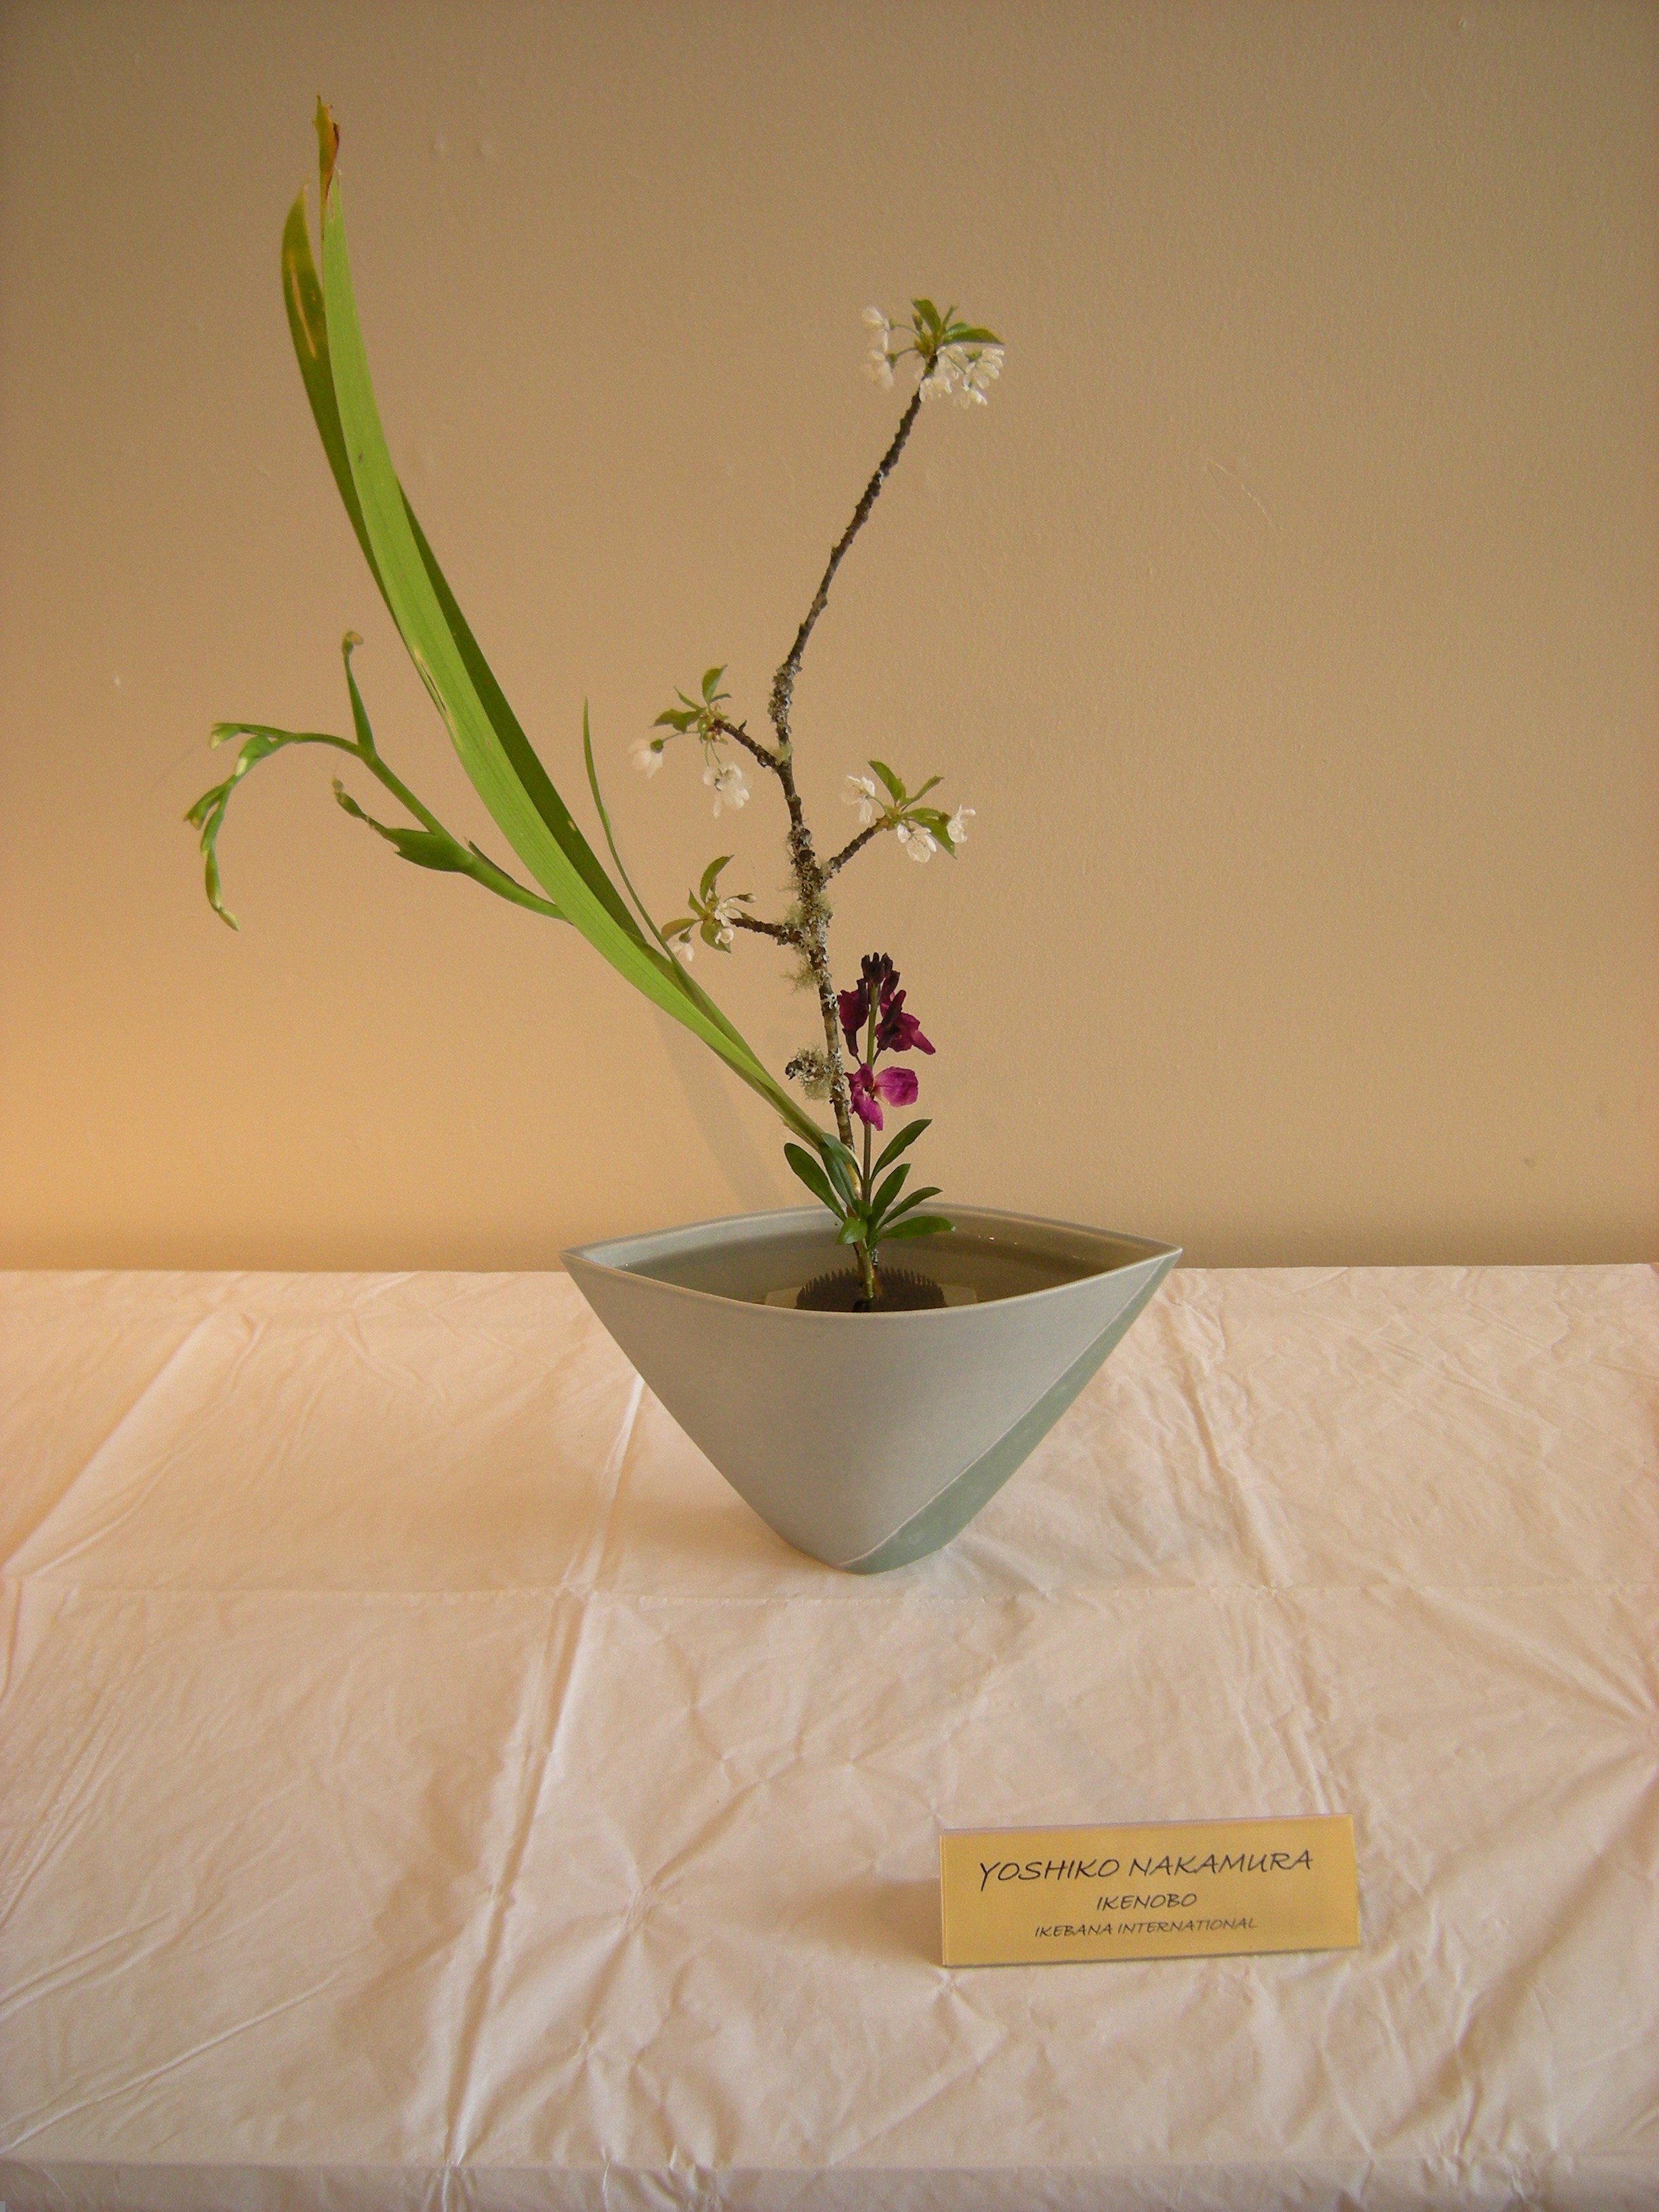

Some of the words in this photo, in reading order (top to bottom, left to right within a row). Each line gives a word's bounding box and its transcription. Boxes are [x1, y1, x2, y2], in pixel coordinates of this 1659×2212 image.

[979, 1859, 1120, 1892] YOSHIKO
[1128, 1849, 1313, 1877] NAKAMURA
[1097, 1893, 1197, 1911] IKENOBO
[1035, 1923, 1112, 1938] IKEBANA
[1118, 1918, 1257, 1934] INTERNATIONAL
